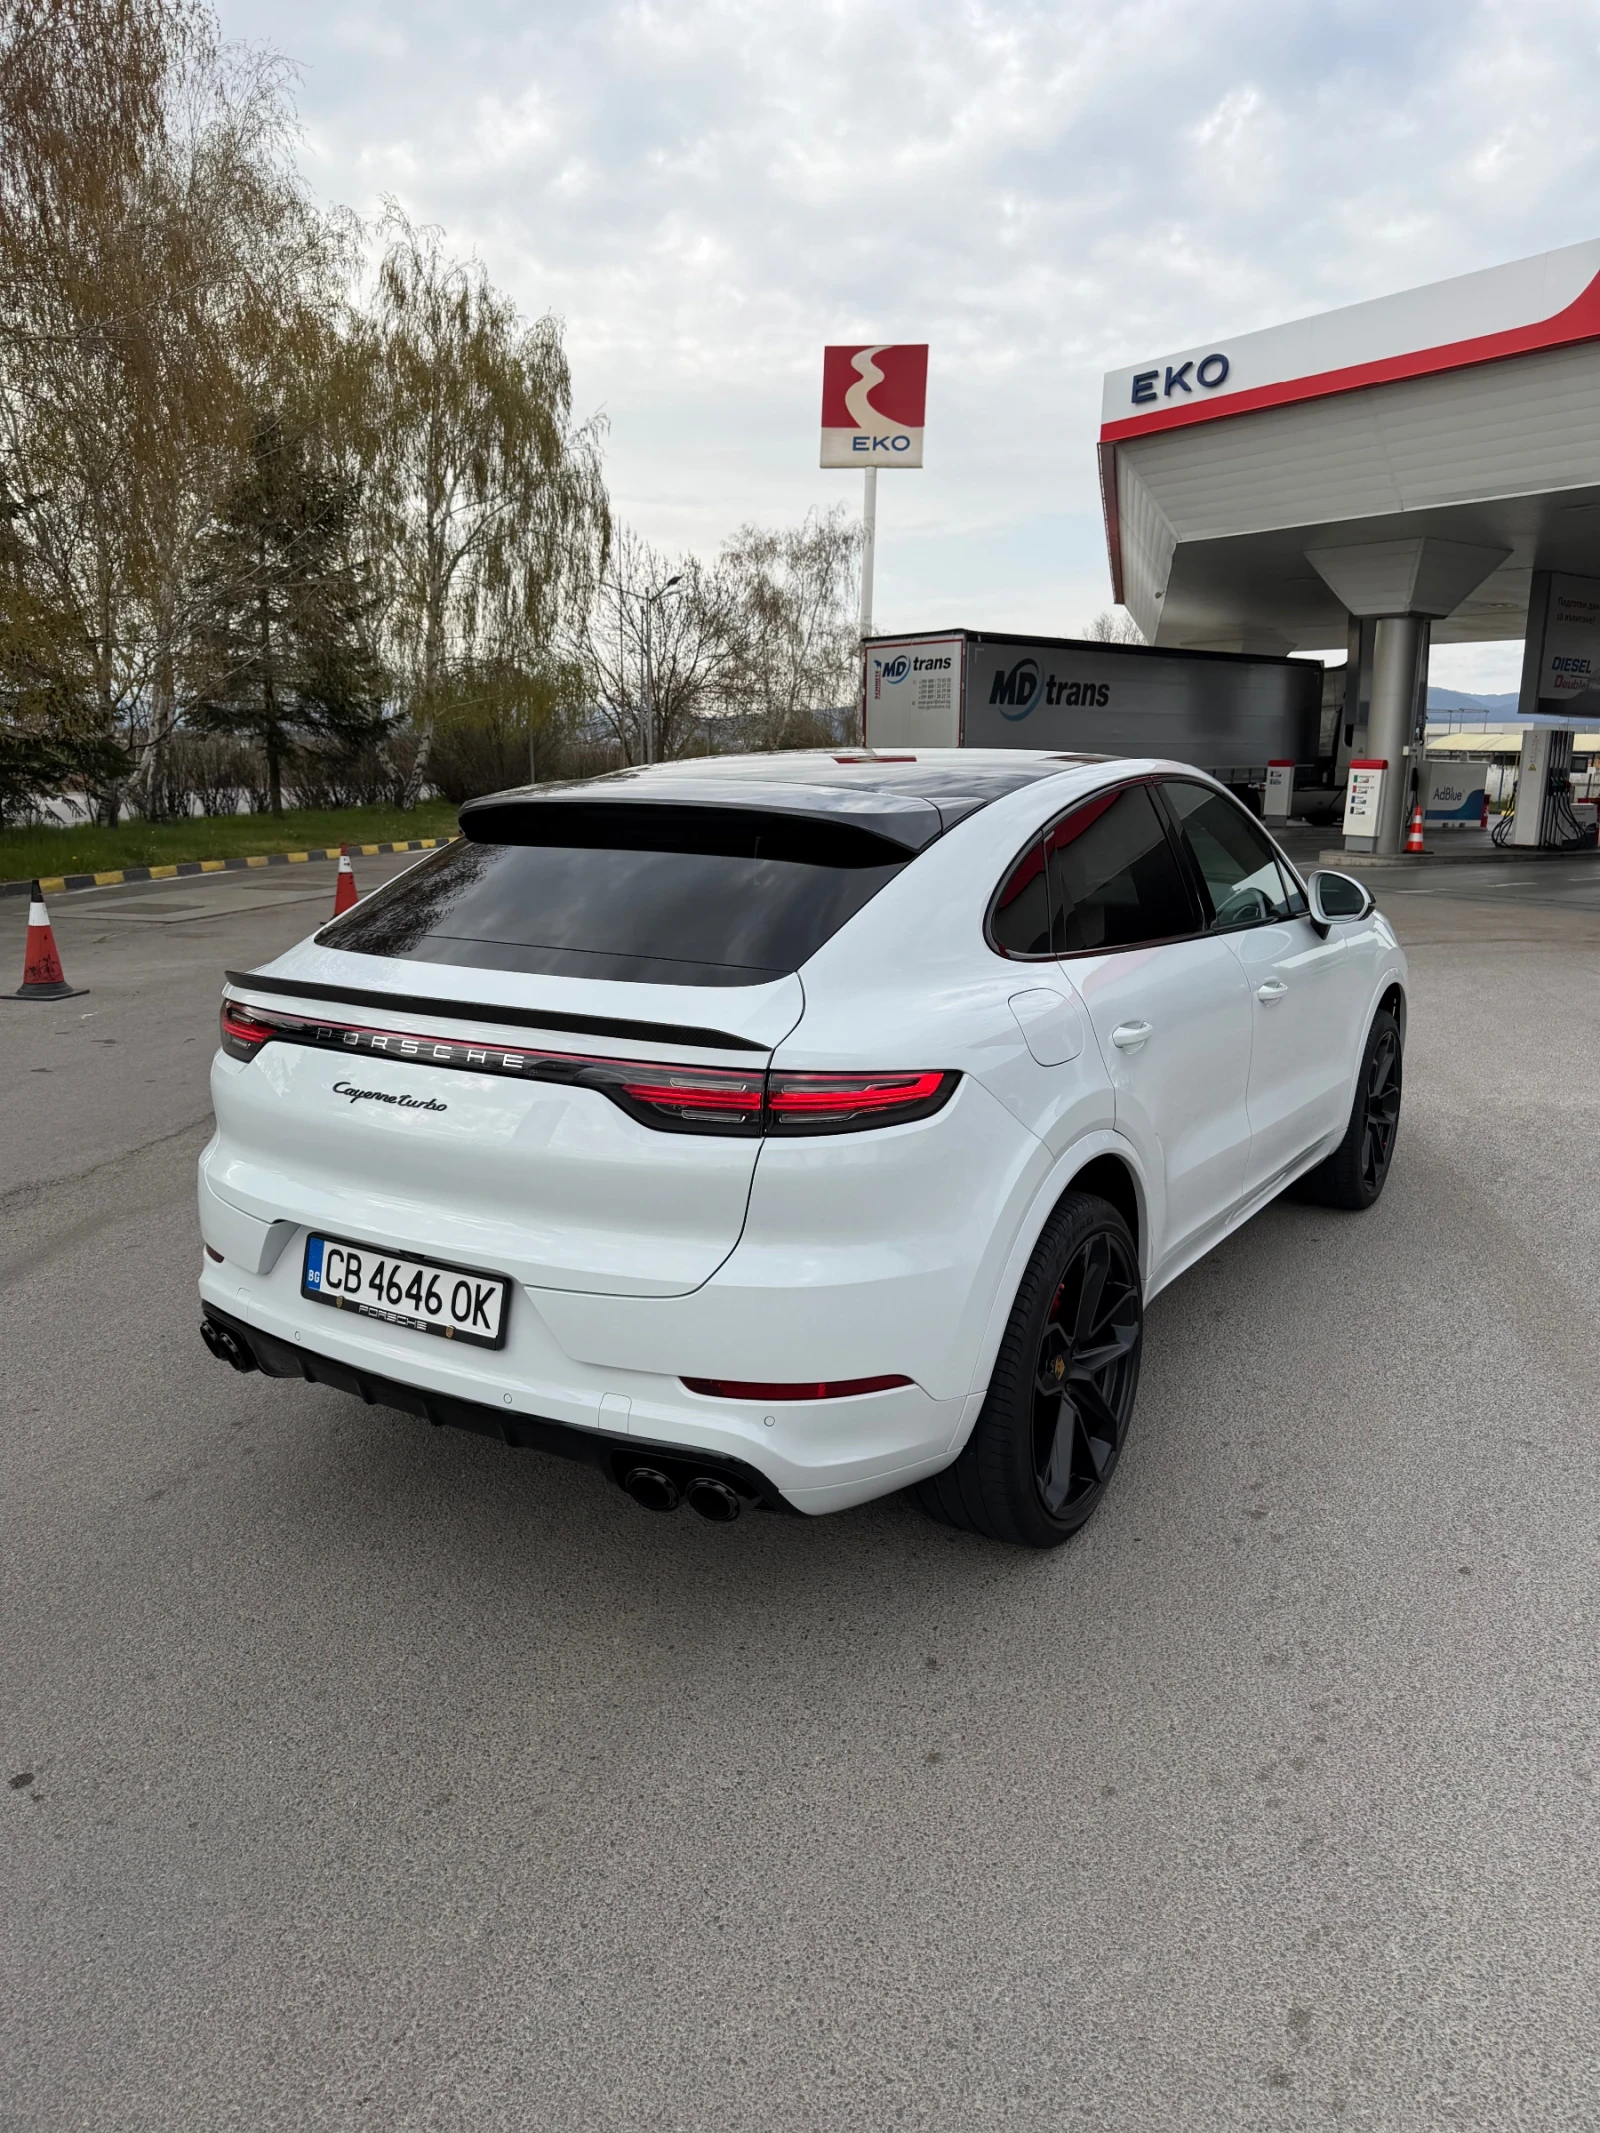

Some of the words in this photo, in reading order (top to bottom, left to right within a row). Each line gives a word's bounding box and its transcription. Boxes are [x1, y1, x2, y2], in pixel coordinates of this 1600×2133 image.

[1131, 353, 1230, 404] EKO
[852, 435, 911, 452] EKO
[882, 661, 907, 677] MD
[913, 656, 952, 671] trans
[1551, 656, 1592, 674] DIESEL
[989, 670, 1038, 705] MD
[1045, 674, 1111, 707] trans
[1432, 787, 1463, 801] AdBlue
[316, 1027, 525, 1068] PORSCHE
[332, 1081, 397, 1103] Cayenne
[307, 1269, 321, 1284] BG
[326, 1248, 363, 1294] CB
[368, 1260, 443, 1316] 4646
[450, 1280, 497, 1330] OK
[358, 1304, 428, 1331] PORSCHE
